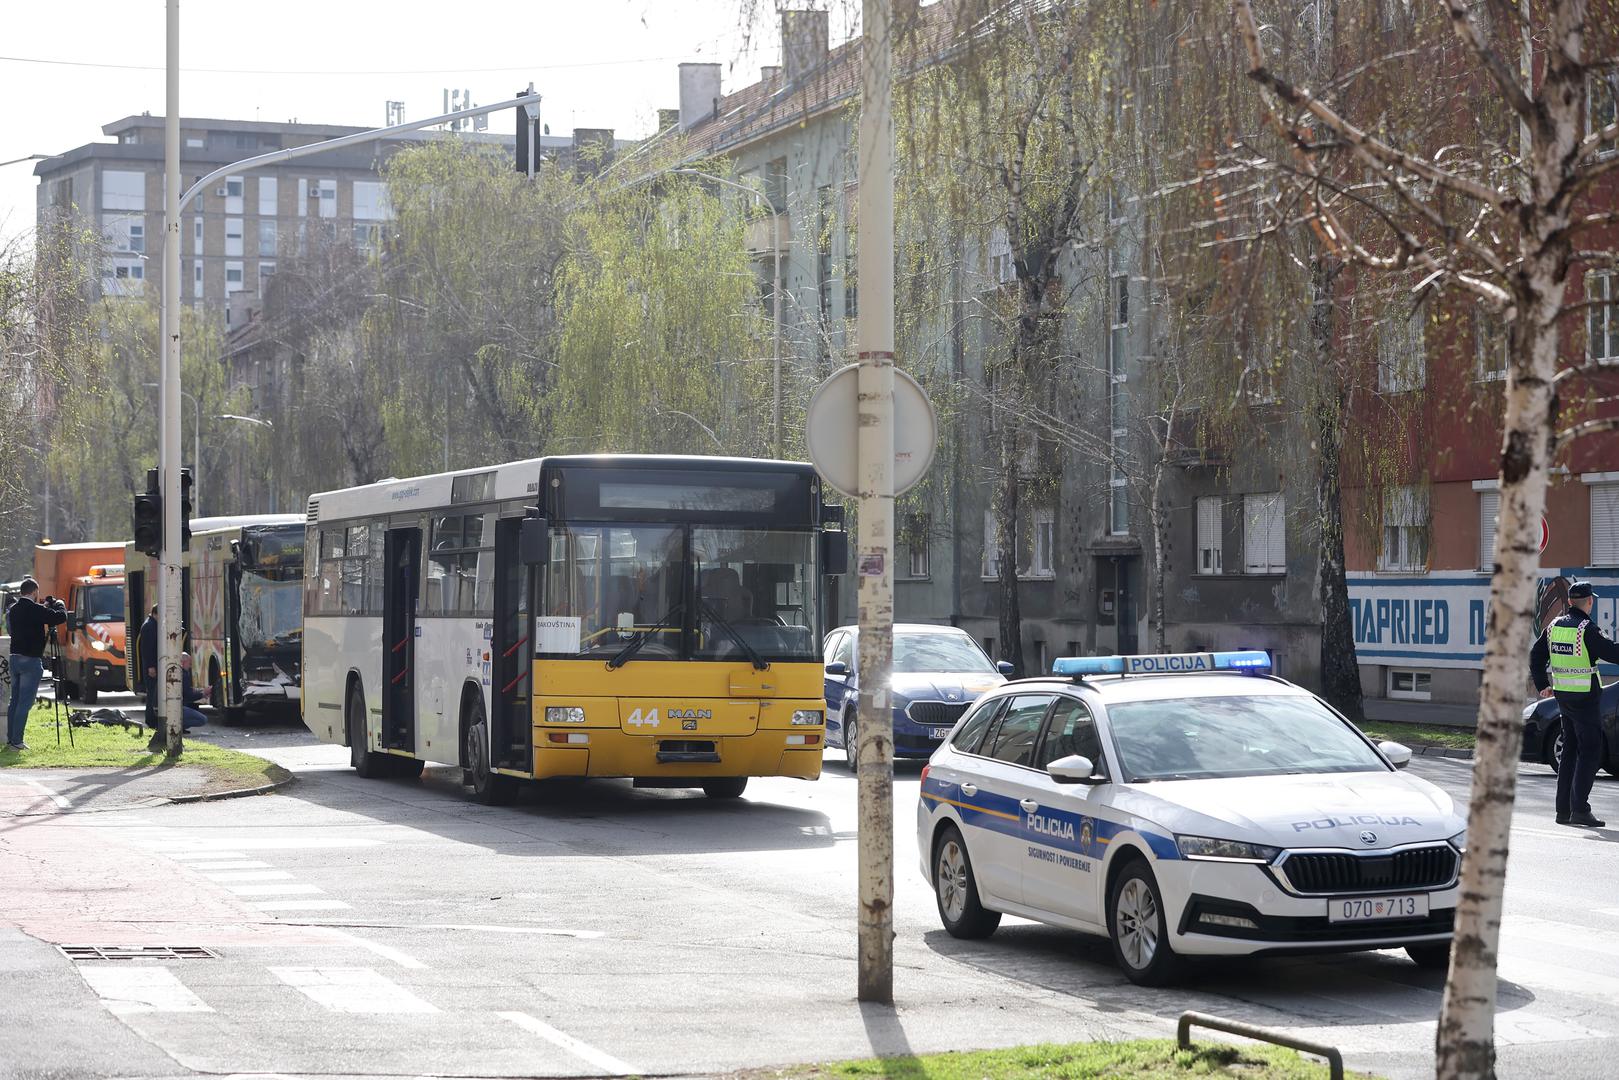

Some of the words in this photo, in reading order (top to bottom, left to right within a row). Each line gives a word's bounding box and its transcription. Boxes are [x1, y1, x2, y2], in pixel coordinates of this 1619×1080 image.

[1348, 598, 1449, 645] NAPRIJED
[1552, 644, 1573, 653] POLICIJA
[1131, 655, 1206, 672] POLICIJA
[627, 707, 660, 728] 44
[667, 708, 712, 719] MAN
[935, 728, 945, 738] ZG
[1027, 813, 1075, 841] POLICIJA
[1291, 815, 1423, 833] POLICIJA
[1028, 846, 1056, 864] SIGURNOST
[1059, 854, 1091, 873] POVJERENJE
[1343, 899, 1373, 919] 070
[1386, 896, 1415, 916] 713
